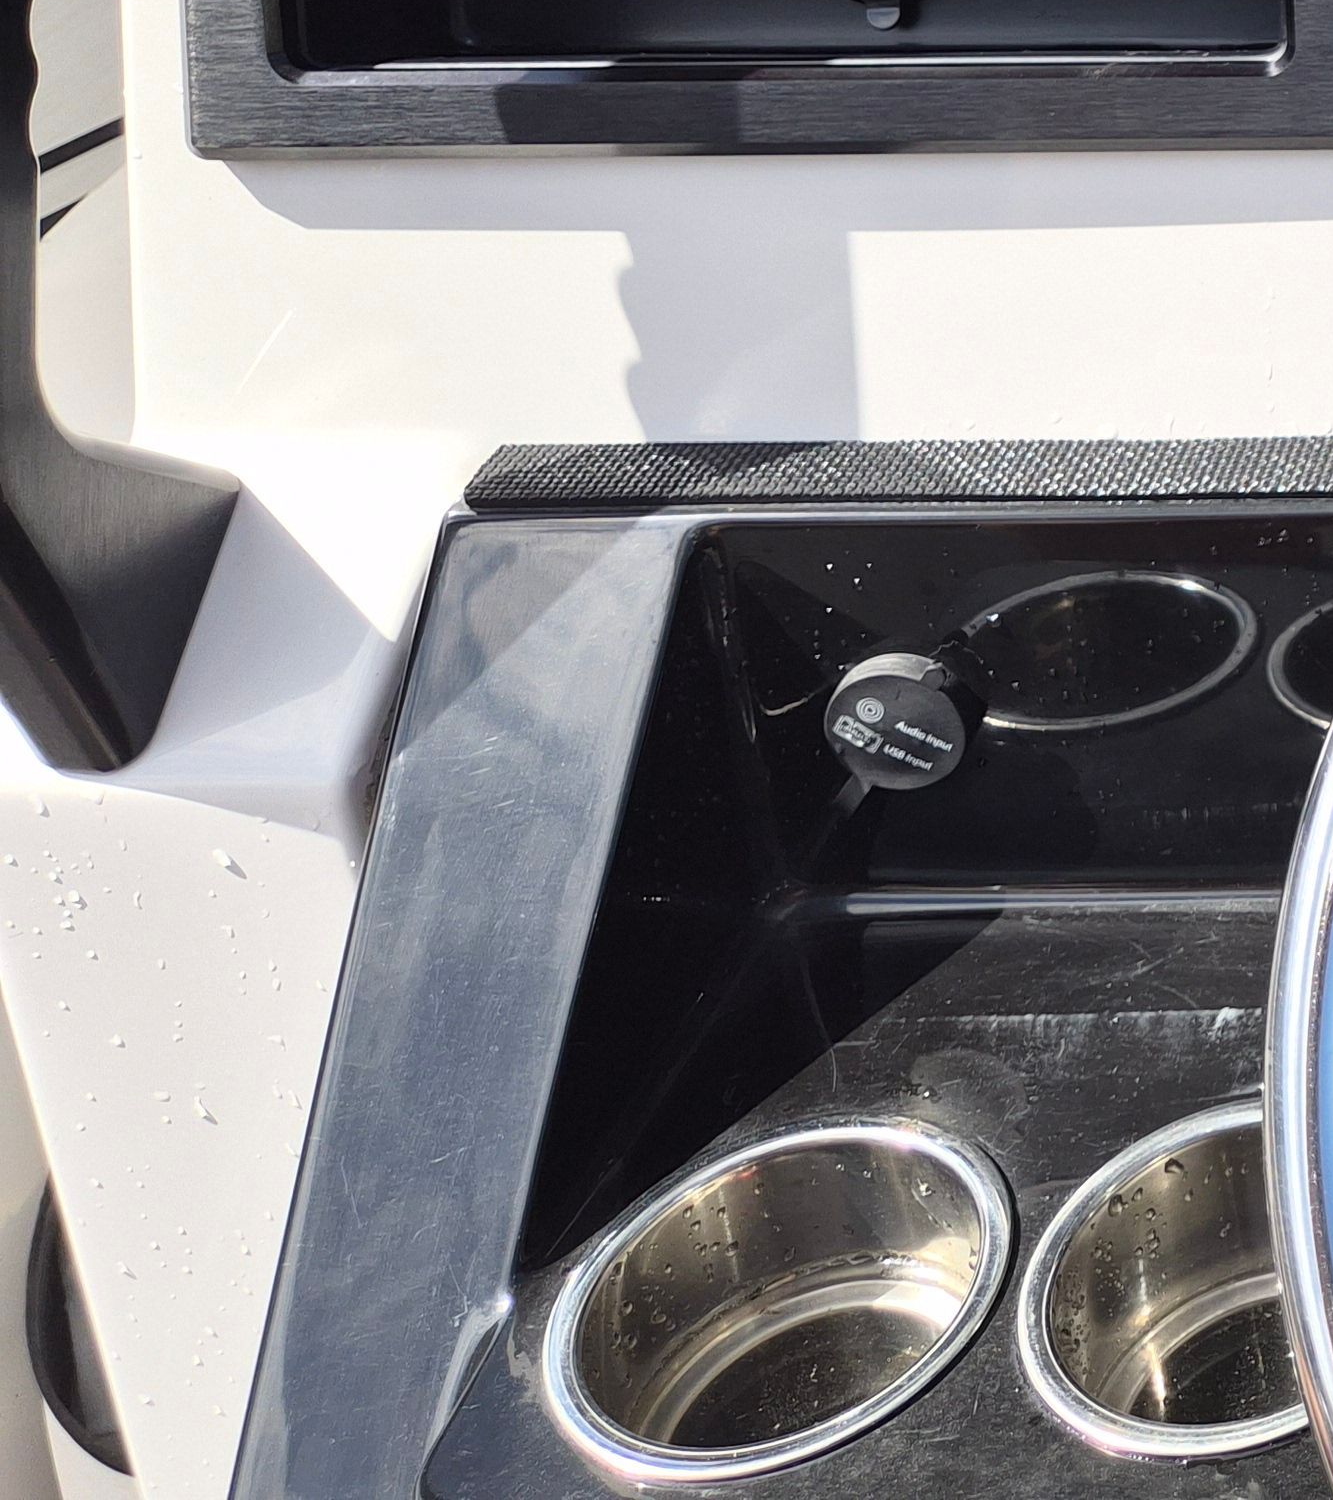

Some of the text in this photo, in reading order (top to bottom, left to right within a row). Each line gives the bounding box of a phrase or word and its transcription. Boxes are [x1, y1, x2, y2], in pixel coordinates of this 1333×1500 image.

[894, 721, 953, 752] Audio Input
[904, 751, 934, 771] Input
